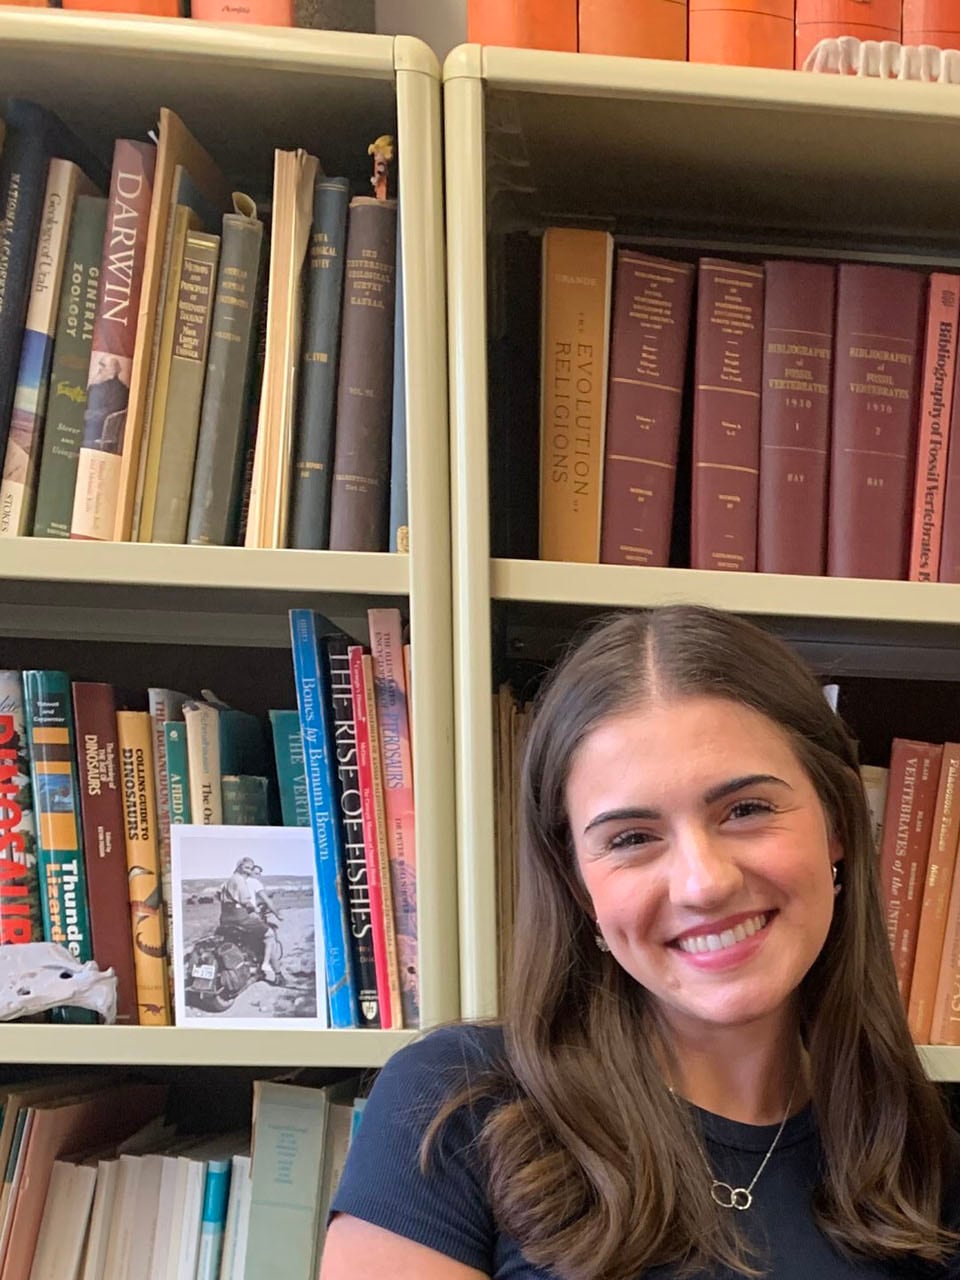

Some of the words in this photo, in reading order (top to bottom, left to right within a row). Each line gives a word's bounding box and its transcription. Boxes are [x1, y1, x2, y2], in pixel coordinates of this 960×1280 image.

[4, 172, 21, 233] NATIONAL
[41, 193, 62, 242] Geology
[39, 244, 53, 260] of
[102, 170, 142, 327] DARWIN
[36, 261, 52, 292] Utah
[66, 262, 83, 338] ZOOLOGY
[82, 266, 99, 340] GENERAL
[768, 343, 831, 360] BIBLIOGRAPHY
[785, 367, 813, 380] FOSSIL
[849, 346, 913, 365] BIBLIOGRAPHY
[928, 320, 953, 421] Bibliography
[768, 378, 829, 395] VERTEBRATES
[850, 382, 910, 399] VERTEBRATES
[866, 373, 895, 385] FOSSIL
[552, 342, 571, 485] RELIGIONS
[574, 343, 593, 496] EVOLUTION
[929, 423, 942, 440] of
[926, 440, 943, 488] Fossil
[1, 492, 13, 532] STOKES
[919, 489, 940, 568] Vertebrates
[302, 677, 315, 721] Bones
[330, 654, 353, 706] THE
[155, 701, 166, 723] THE
[85, 734, 101, 796] DINOSAURS
[135, 748, 145, 793] COLLINS
[156, 729, 169, 808] IGUANODON
[289, 731, 304, 765] THE
[335, 720, 359, 777] RISE
[381, 710, 404, 790] PTEROSAURS
[122, 748, 139, 841] DINOSAURS
[171, 773, 181, 782] A
[171, 783, 183, 813] FIELD
[202, 784, 212, 803] The
[308, 749, 326, 807] Barnum
[138, 794, 148, 822] GUIDE
[202, 808, 214, 825] Ori
[293, 775, 311, 826] VERTE
[341, 788, 363, 831] OF
[896, 757, 918, 857] VERTEBRATES
[141, 823, 149, 841] TO
[315, 811, 329, 861] Brown
[890, 876, 903, 897] the
[891, 860, 903, 876] of
[61, 859, 83, 958] Thunde
[345, 843, 373, 939] FISHES
